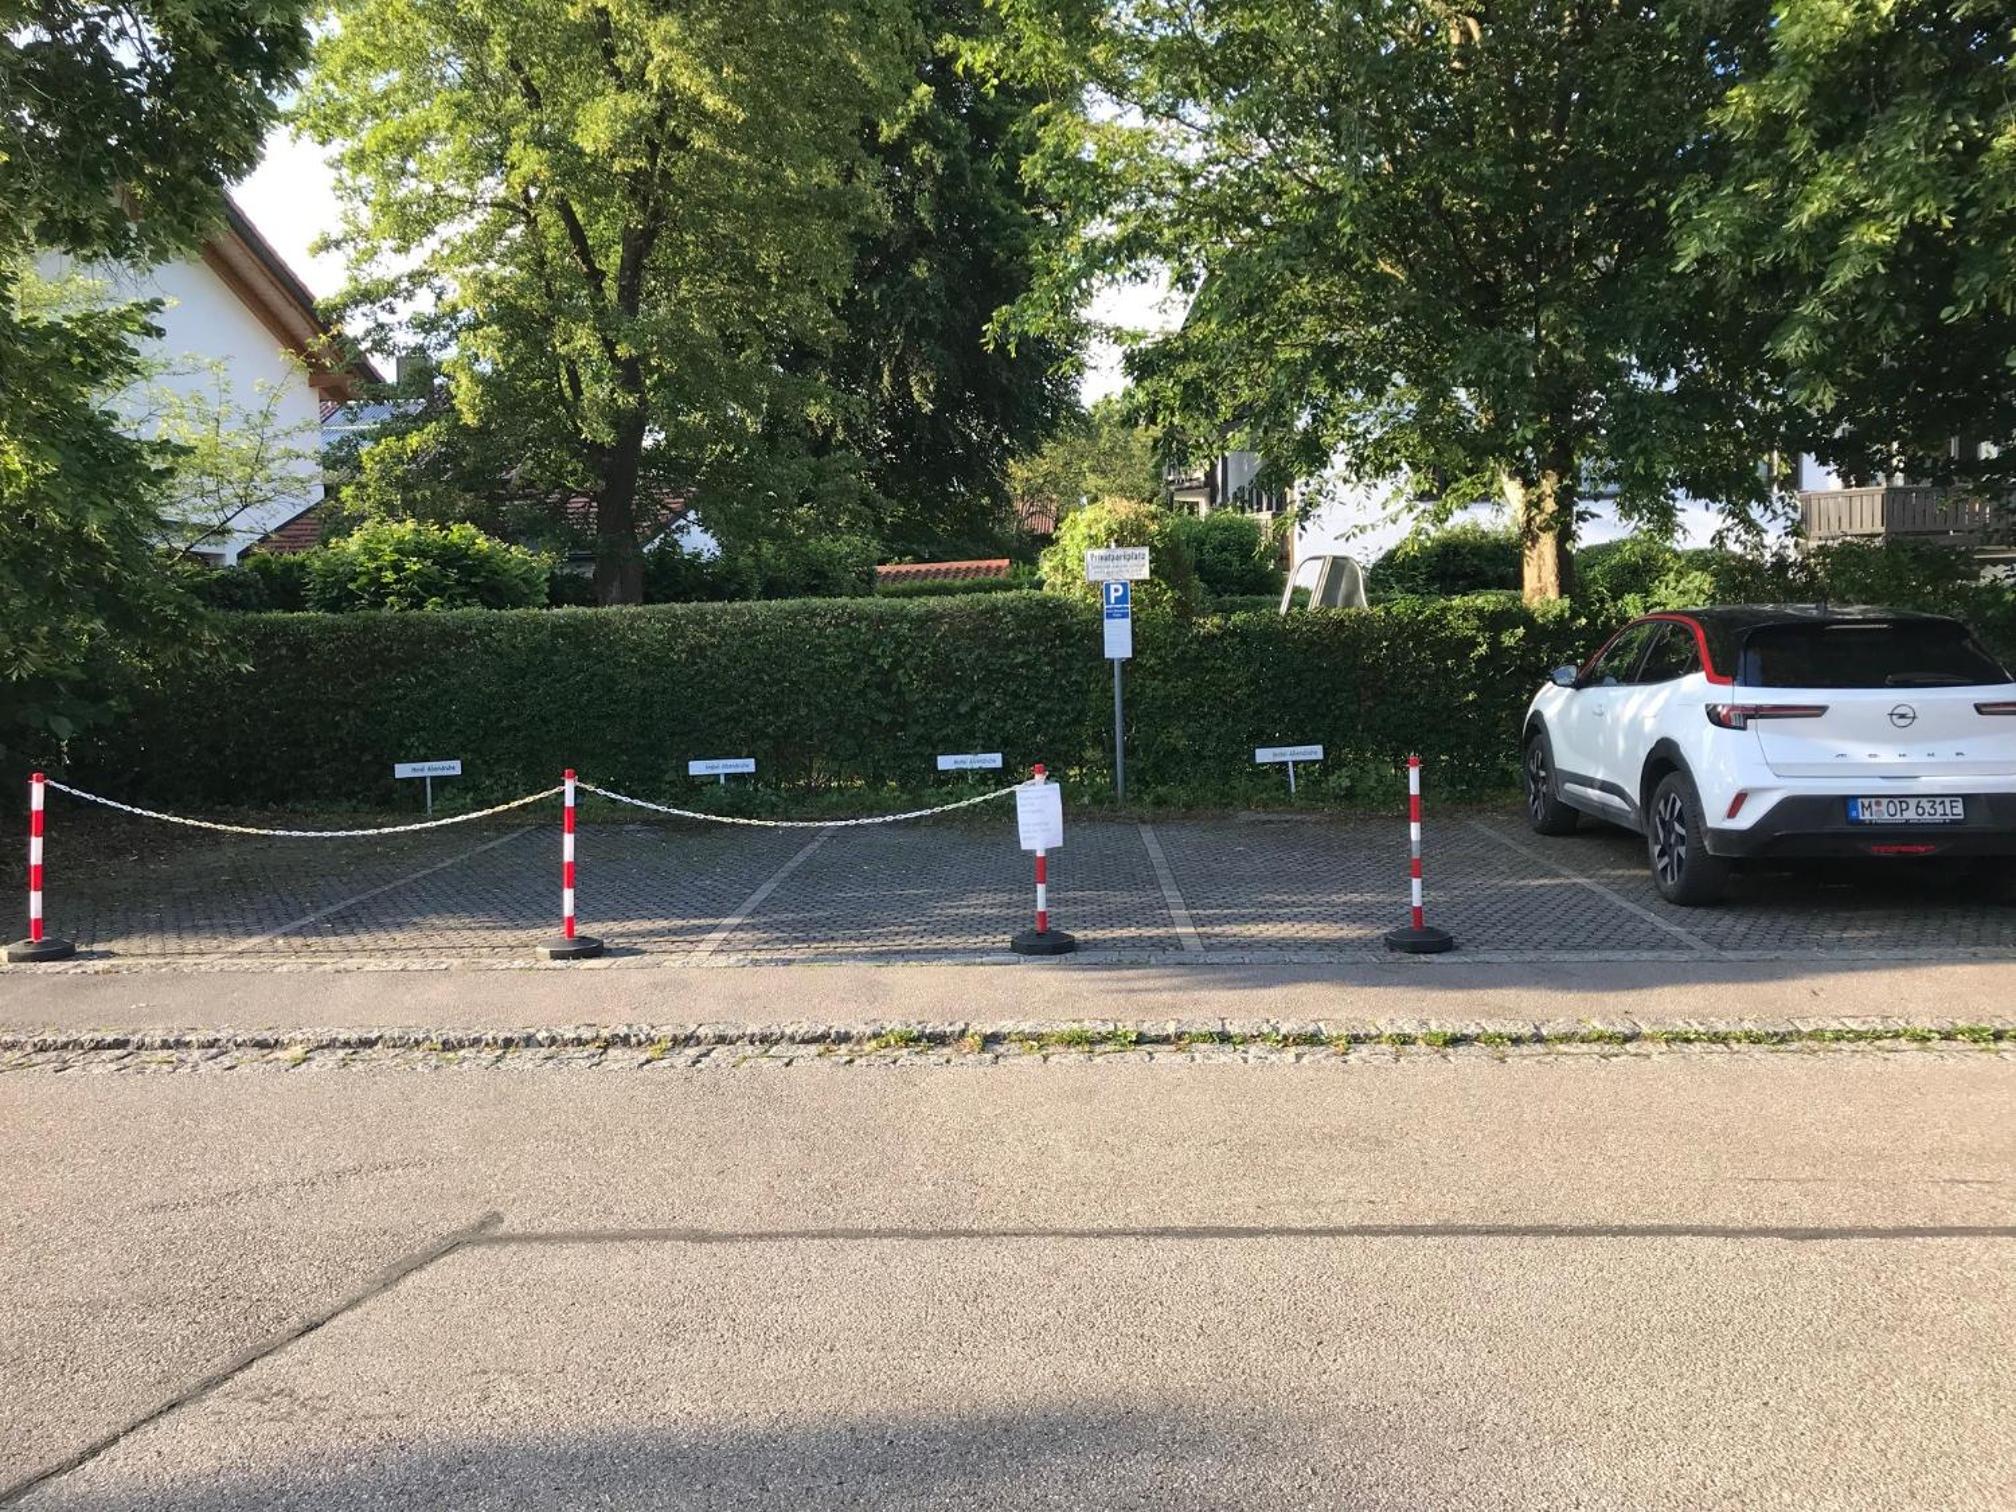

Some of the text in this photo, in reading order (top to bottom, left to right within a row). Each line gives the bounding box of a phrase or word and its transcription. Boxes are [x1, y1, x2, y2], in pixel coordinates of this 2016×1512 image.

[1110, 584, 1123, 604] P
[1860, 799, 1962, 817] M OP 631E
